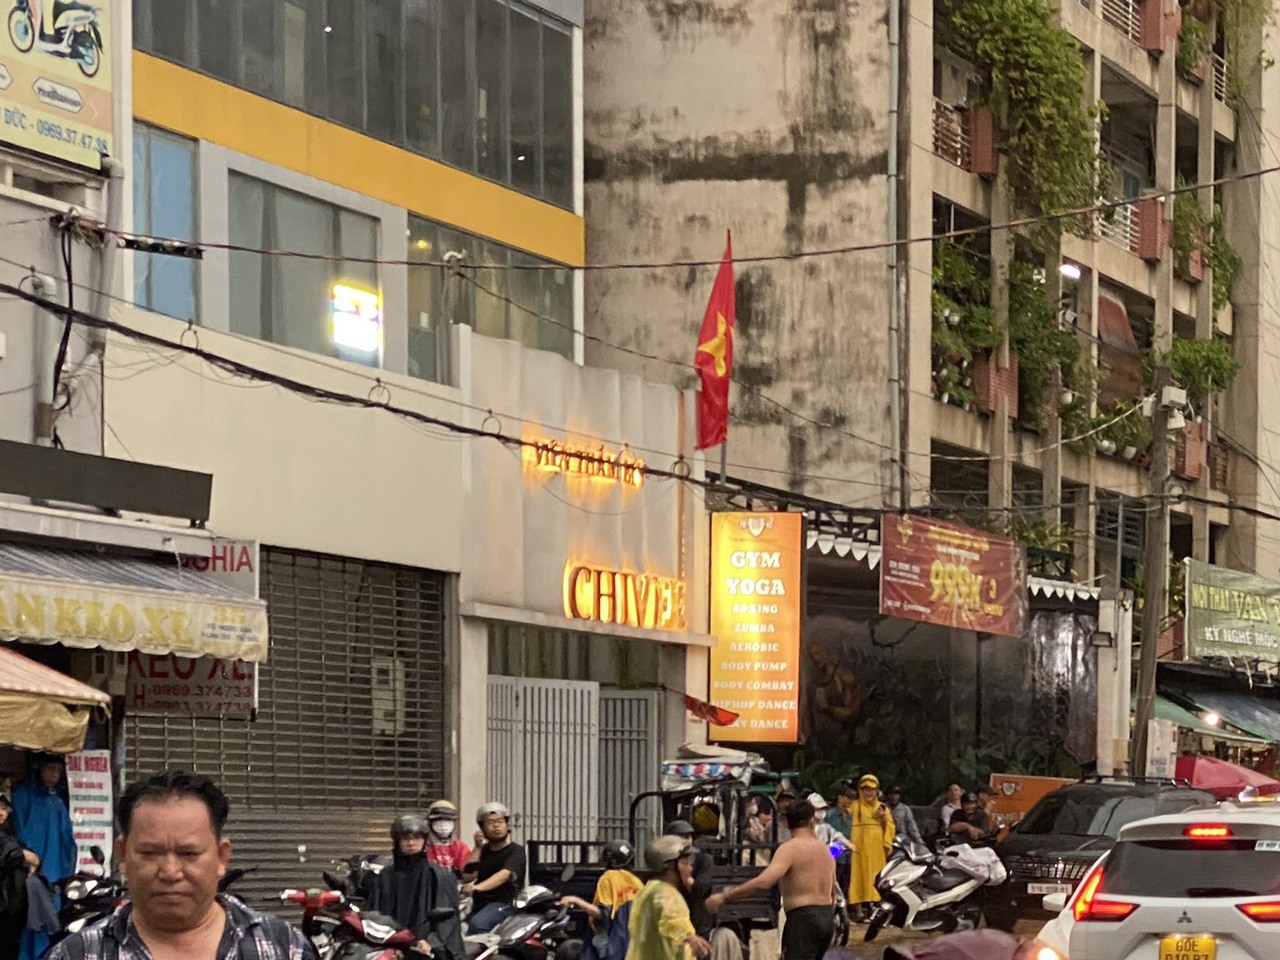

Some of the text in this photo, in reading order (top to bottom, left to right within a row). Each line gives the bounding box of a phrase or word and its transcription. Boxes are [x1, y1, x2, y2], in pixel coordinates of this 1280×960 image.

[730, 550, 781, 569] GYM
[726, 577, 786, 596] YOGA
[930, 559, 984, 609] 999K
[732, 603, 779, 615] BOXING
[53, 597, 134, 642] KEO
[144, 607, 194, 646] XE
[734, 622, 776, 634] ZUMBA
[729, 642, 780, 653] AEROBIC
[721, 661, 788, 672] BODY PUMP
[713, 680, 795, 692] BODY COMBAT
[758, 700, 797, 711] DANCE
[750, 719, 789, 730] DANCE
[1176, 940, 1199, 952] 60E
